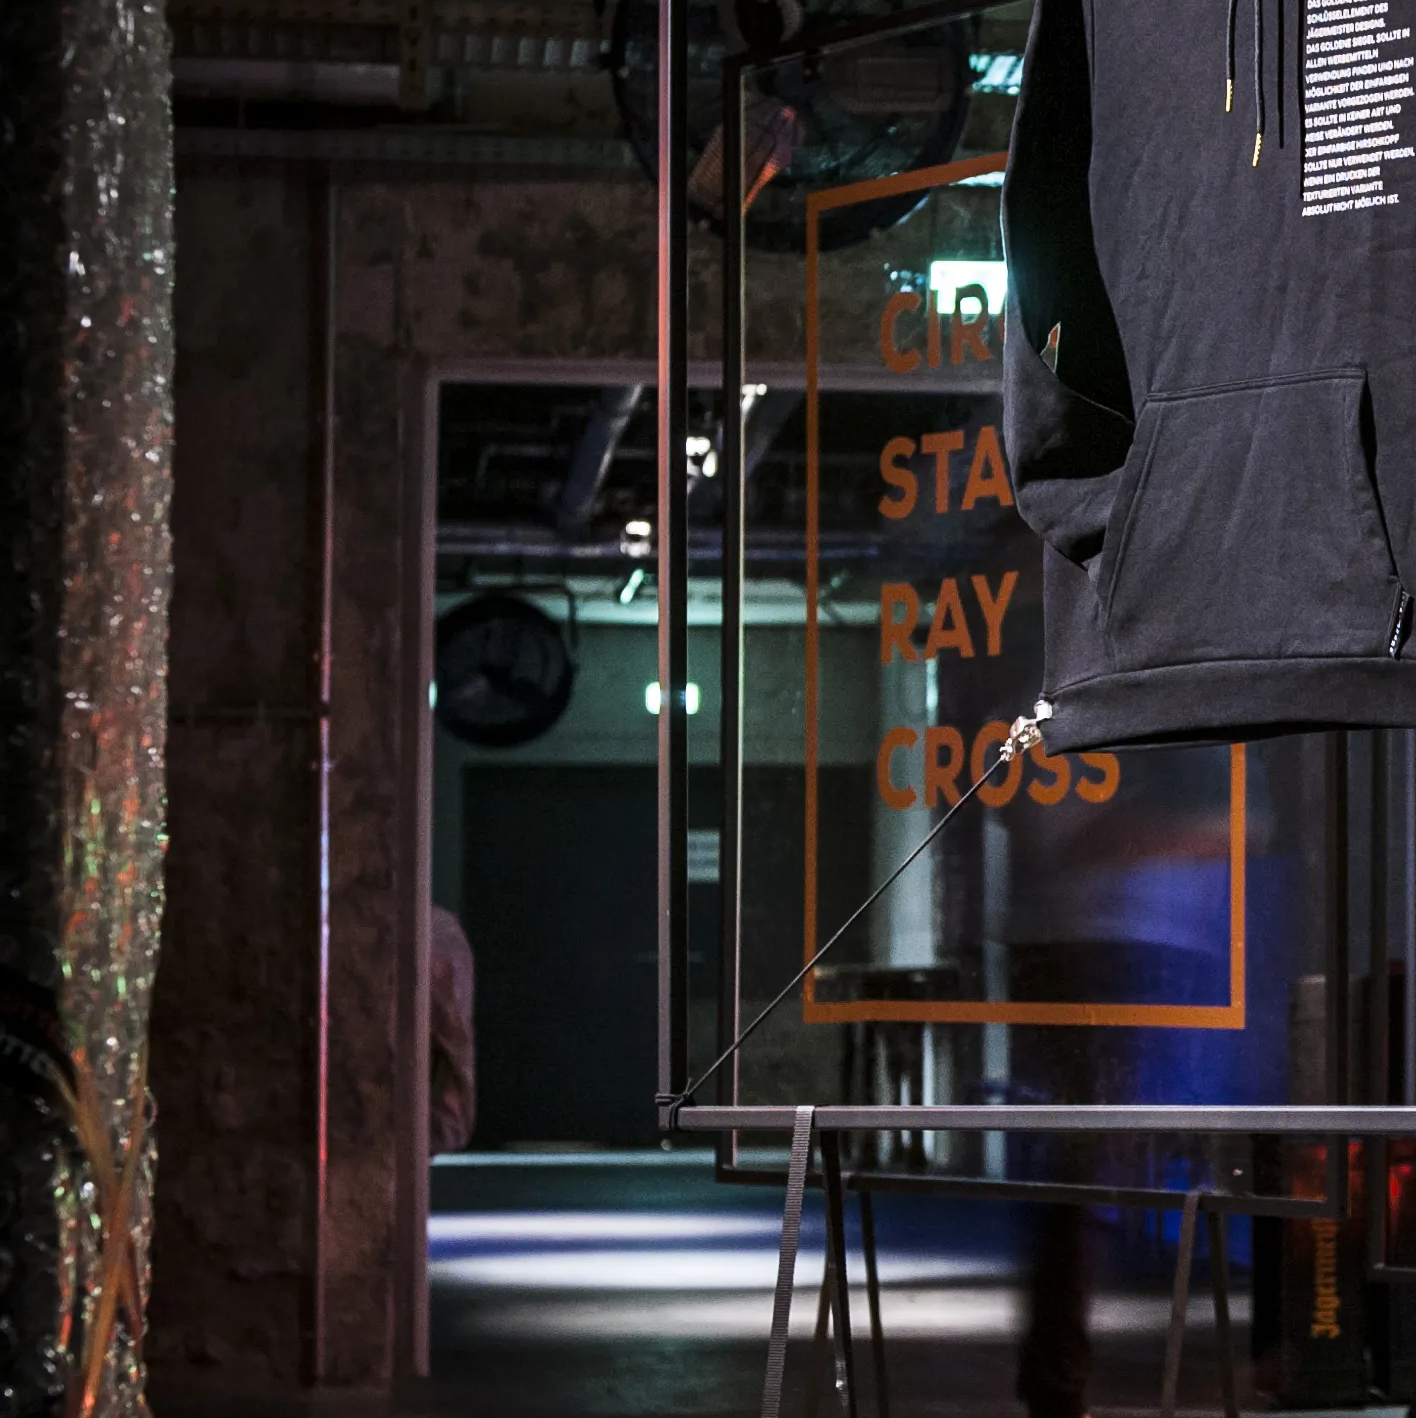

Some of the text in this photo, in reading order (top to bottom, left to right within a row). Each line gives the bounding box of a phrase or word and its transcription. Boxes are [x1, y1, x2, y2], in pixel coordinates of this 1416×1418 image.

[879, 285, 1006, 375] CIR
[879, 426, 1015, 520] STA
[880, 571, 1018, 664] RAY
[876, 721, 1121, 810] CROSS
